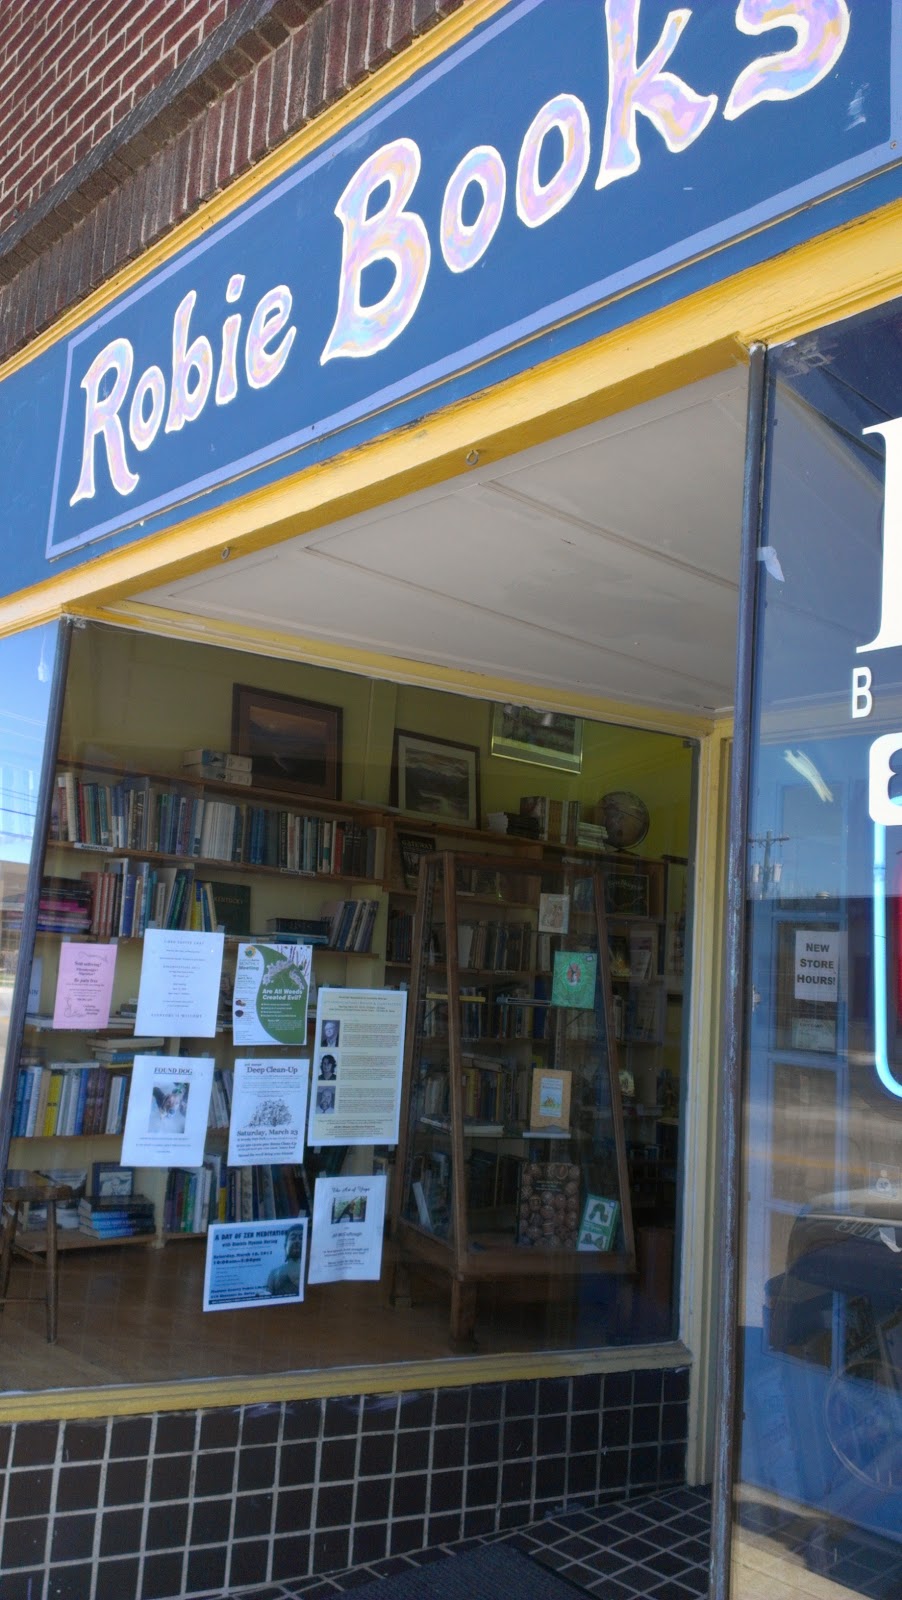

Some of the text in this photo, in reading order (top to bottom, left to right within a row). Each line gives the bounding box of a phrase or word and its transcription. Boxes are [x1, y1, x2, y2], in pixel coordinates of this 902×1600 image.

[70, 0, 852, 507] Robie Books
[805, 942, 830, 953] NEW
[799, 958, 834, 969] STORE
[796, 973, 836, 986] HOURS!
[154, 1066, 193, 1075] FOUND DOG
[246, 1066, 265, 1074] Deep
[266, 1065, 298, 1074] Clean-Up
